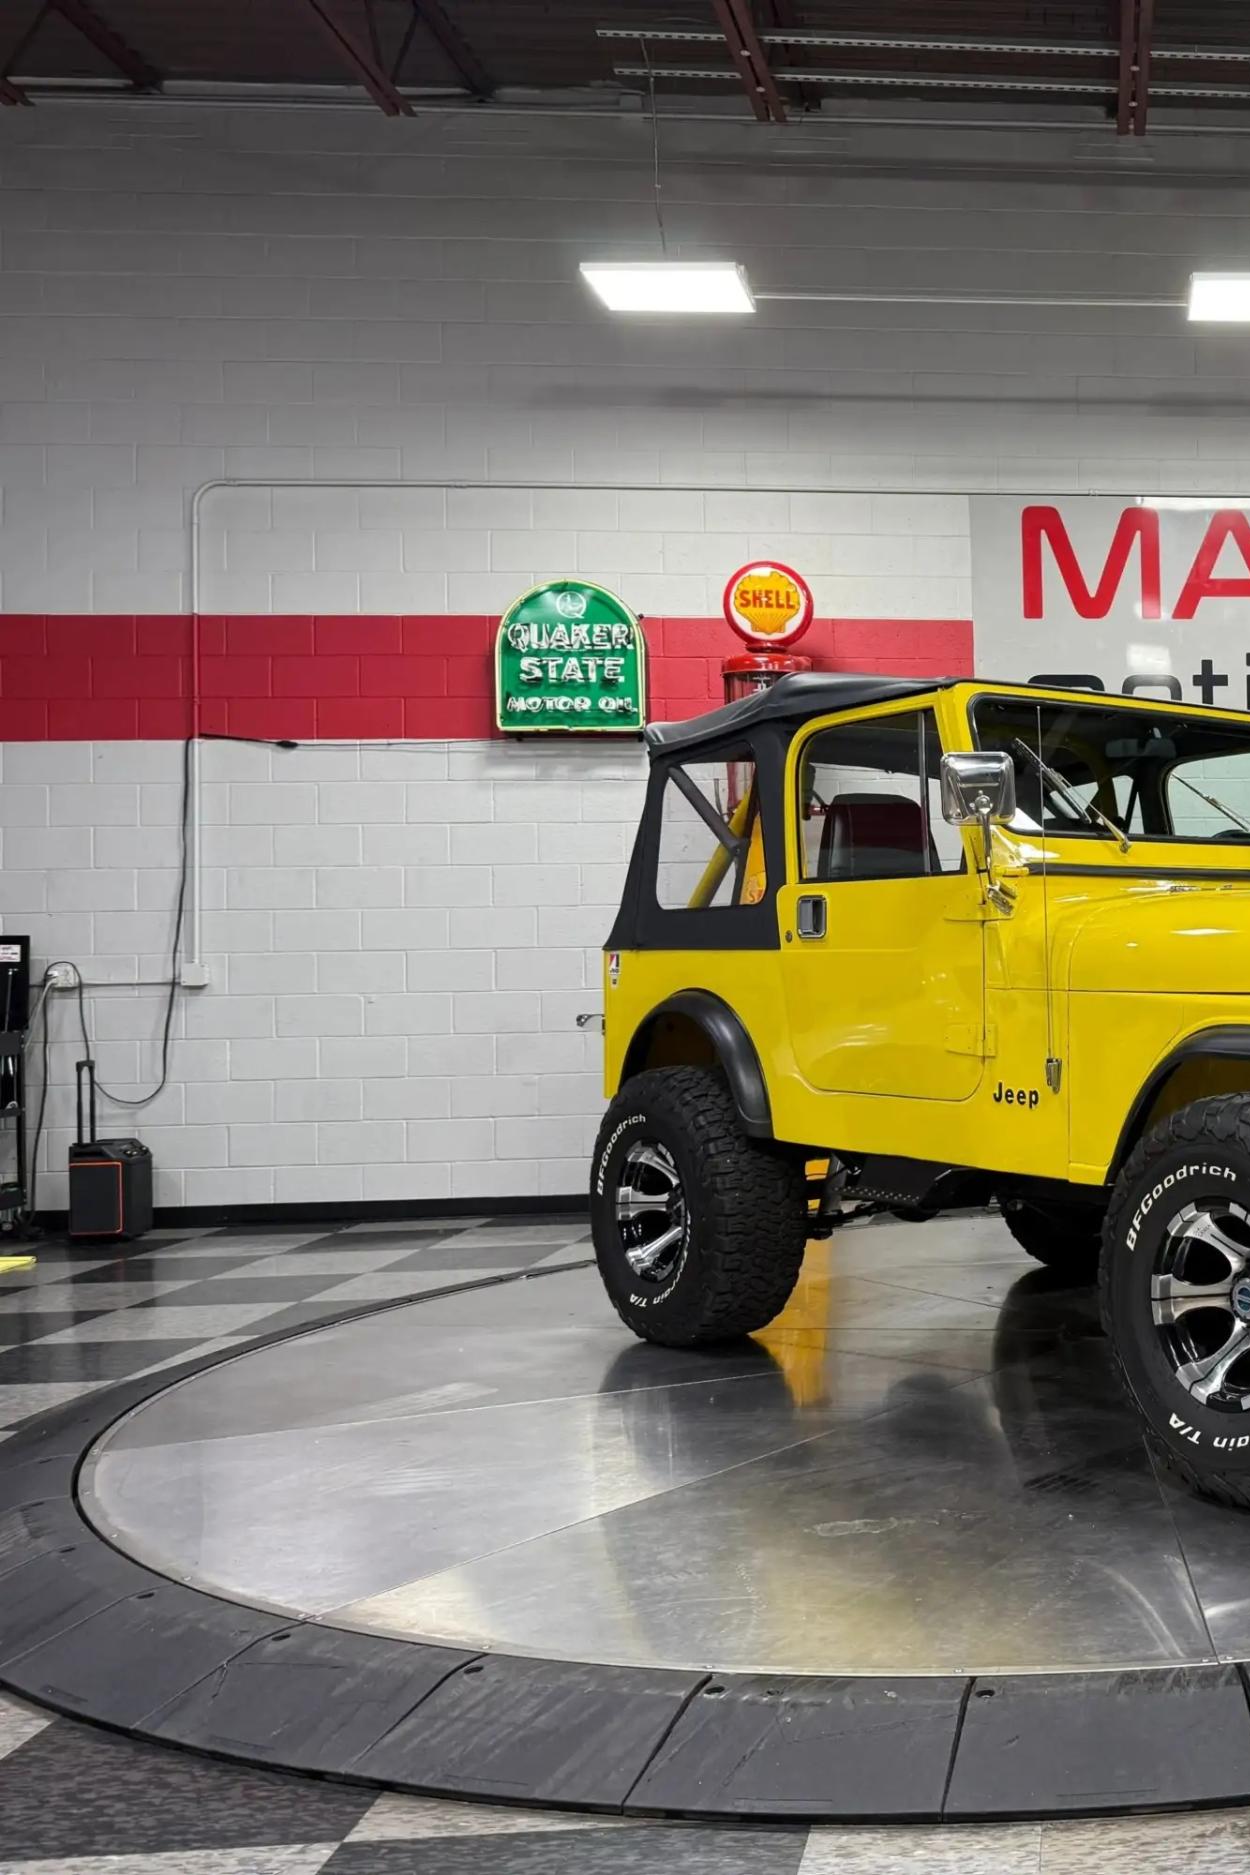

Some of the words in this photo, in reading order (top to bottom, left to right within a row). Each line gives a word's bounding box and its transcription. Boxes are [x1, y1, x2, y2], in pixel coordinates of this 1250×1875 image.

[739, 590, 796, 610] SHELL
[507, 622, 635, 652] QUAKER
[519, 656, 625, 683] STATE
[506, 696, 592, 713] MOTOR
[993, 1081, 1039, 1109] Jeep
[596, 1113, 646, 1196] BFGoodrich
[1126, 1162, 1237, 1251] BFGoodrich
[629, 1293, 648, 1308] T/A
[1168, 1411, 1203, 1445] T/A
